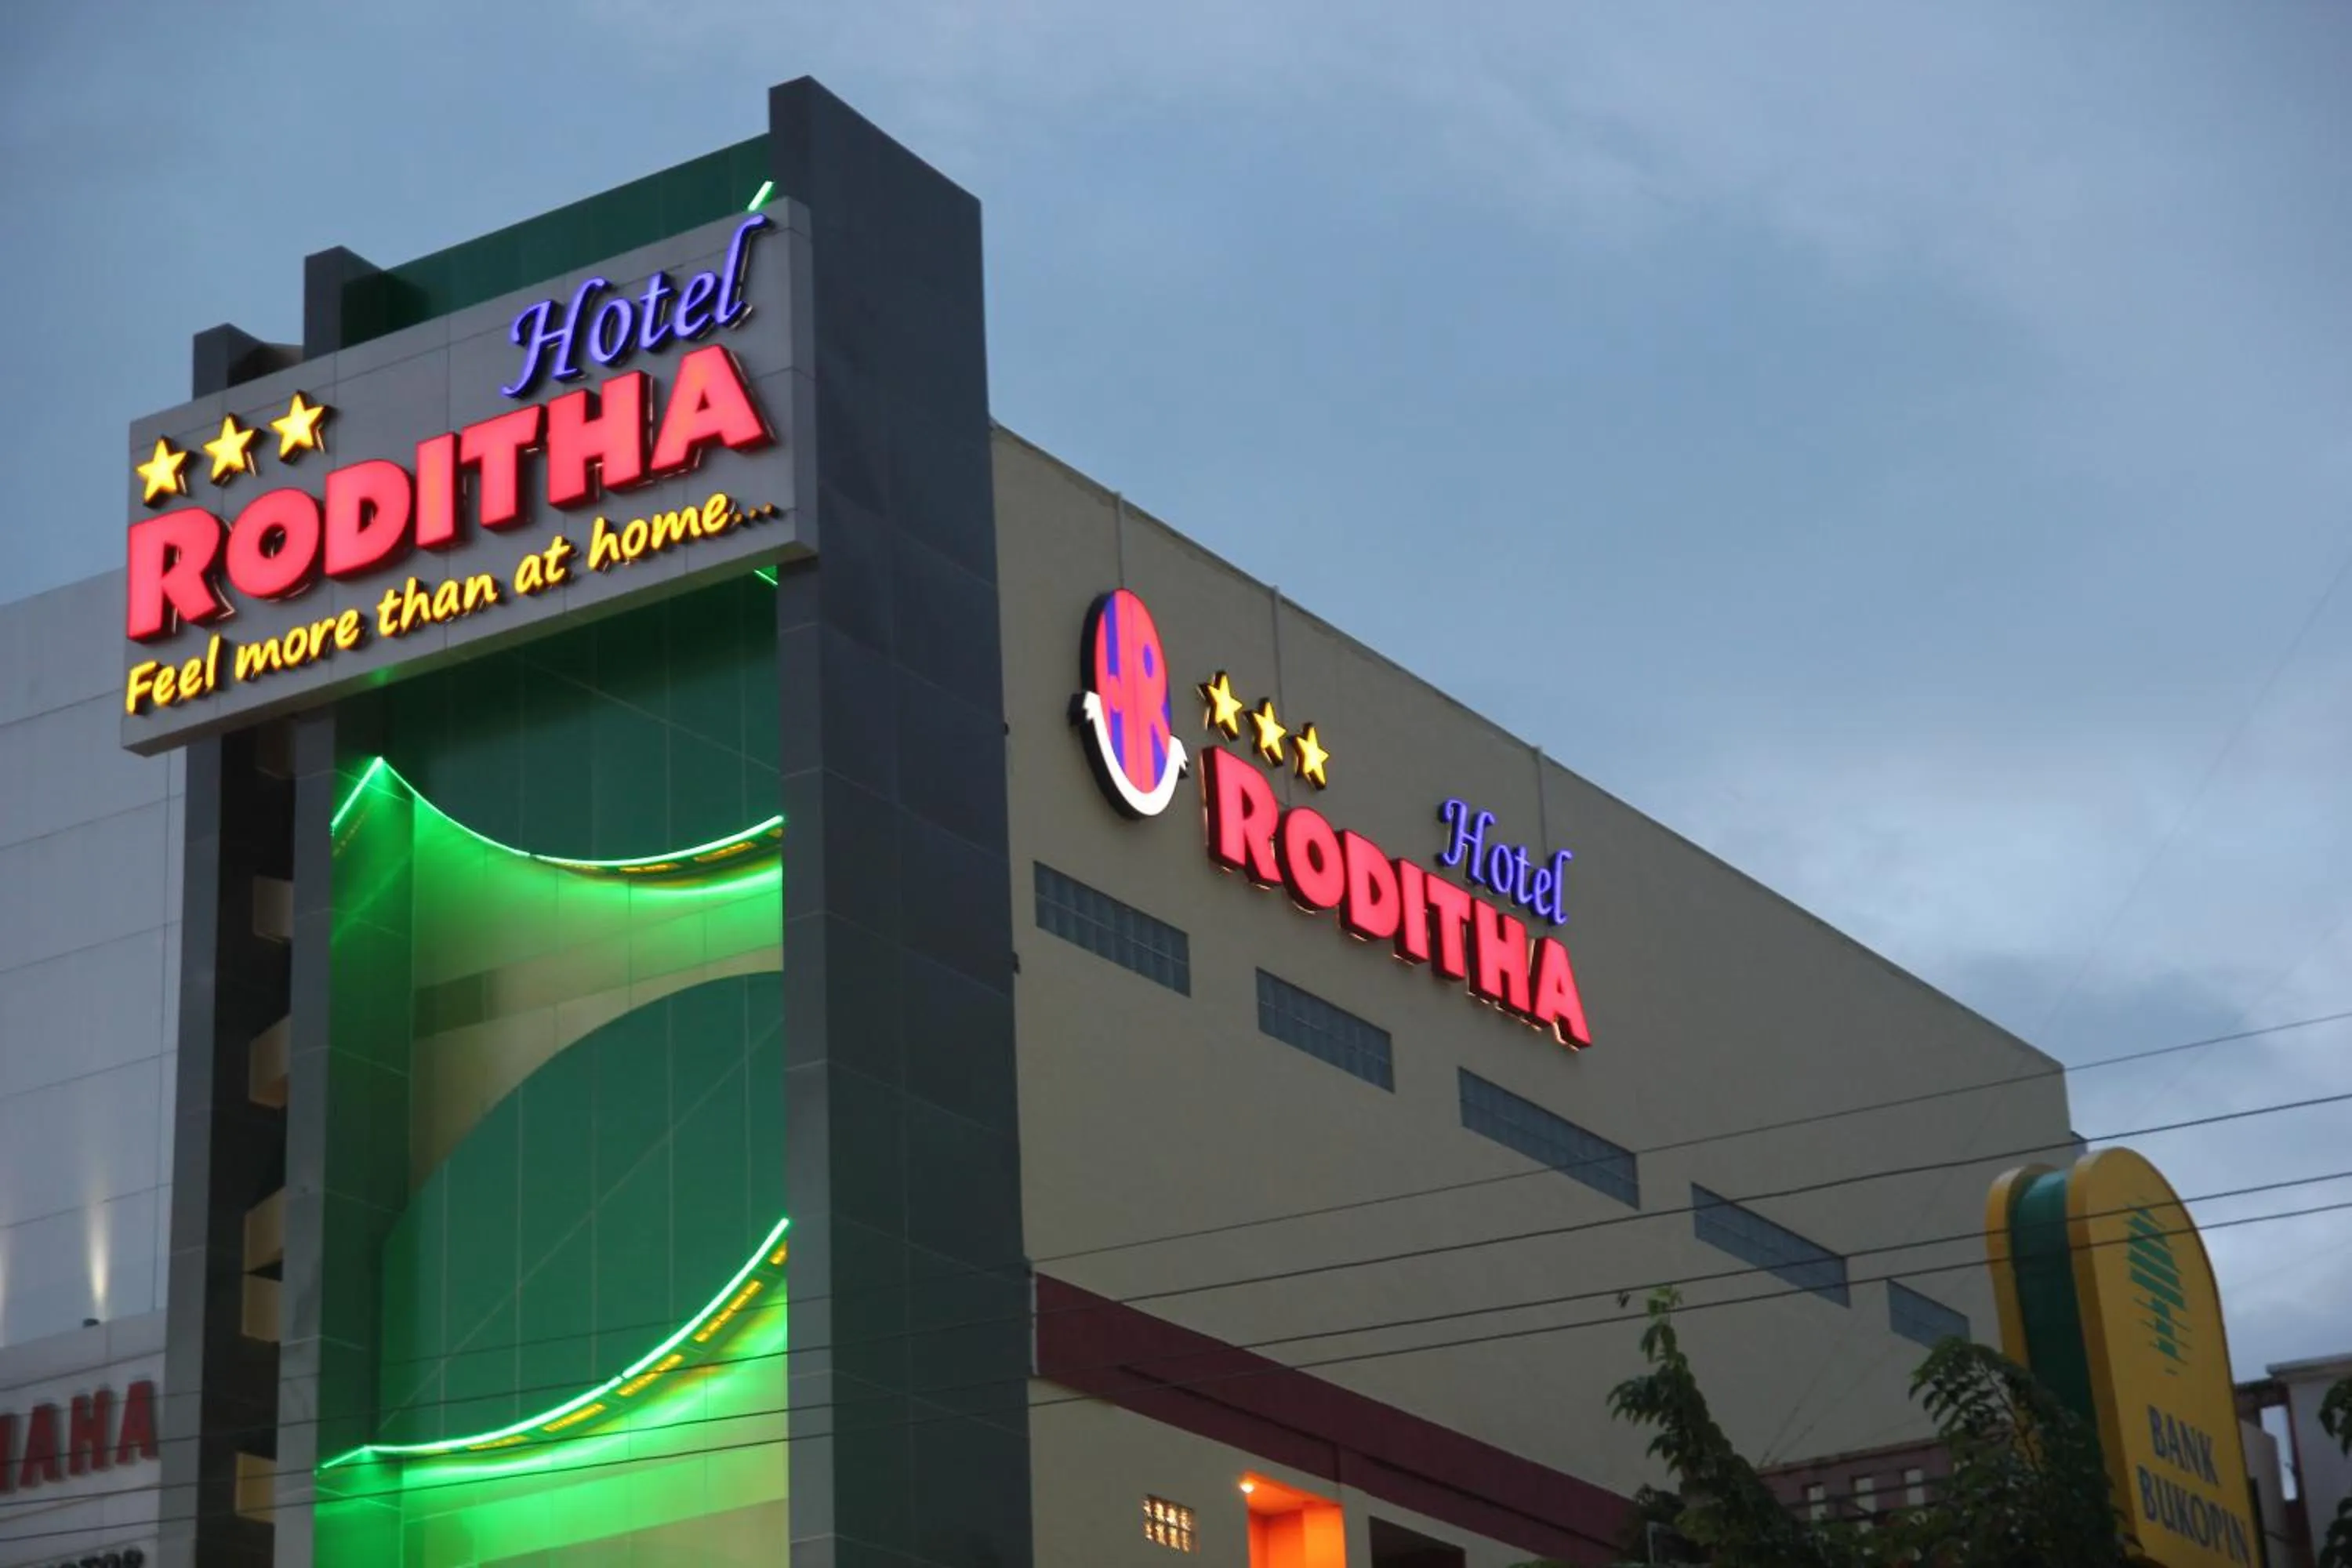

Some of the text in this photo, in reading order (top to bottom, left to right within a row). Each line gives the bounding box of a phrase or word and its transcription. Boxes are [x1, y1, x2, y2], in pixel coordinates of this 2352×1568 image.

[503, 213, 771, 396] Hotel
[126, 345, 775, 641] RODITHA
[125, 634, 220, 717] Feel
[234, 608, 361, 681] more
[377, 576, 497, 637] than
[514, 535, 571, 595] at
[1206, 745, 1592, 1051] RODITHA
[1440, 798, 1573, 925] Hotel
[2136, 1464, 2251, 1568] BUKOPIN
[2147, 1404, 2220, 1488] BANK
